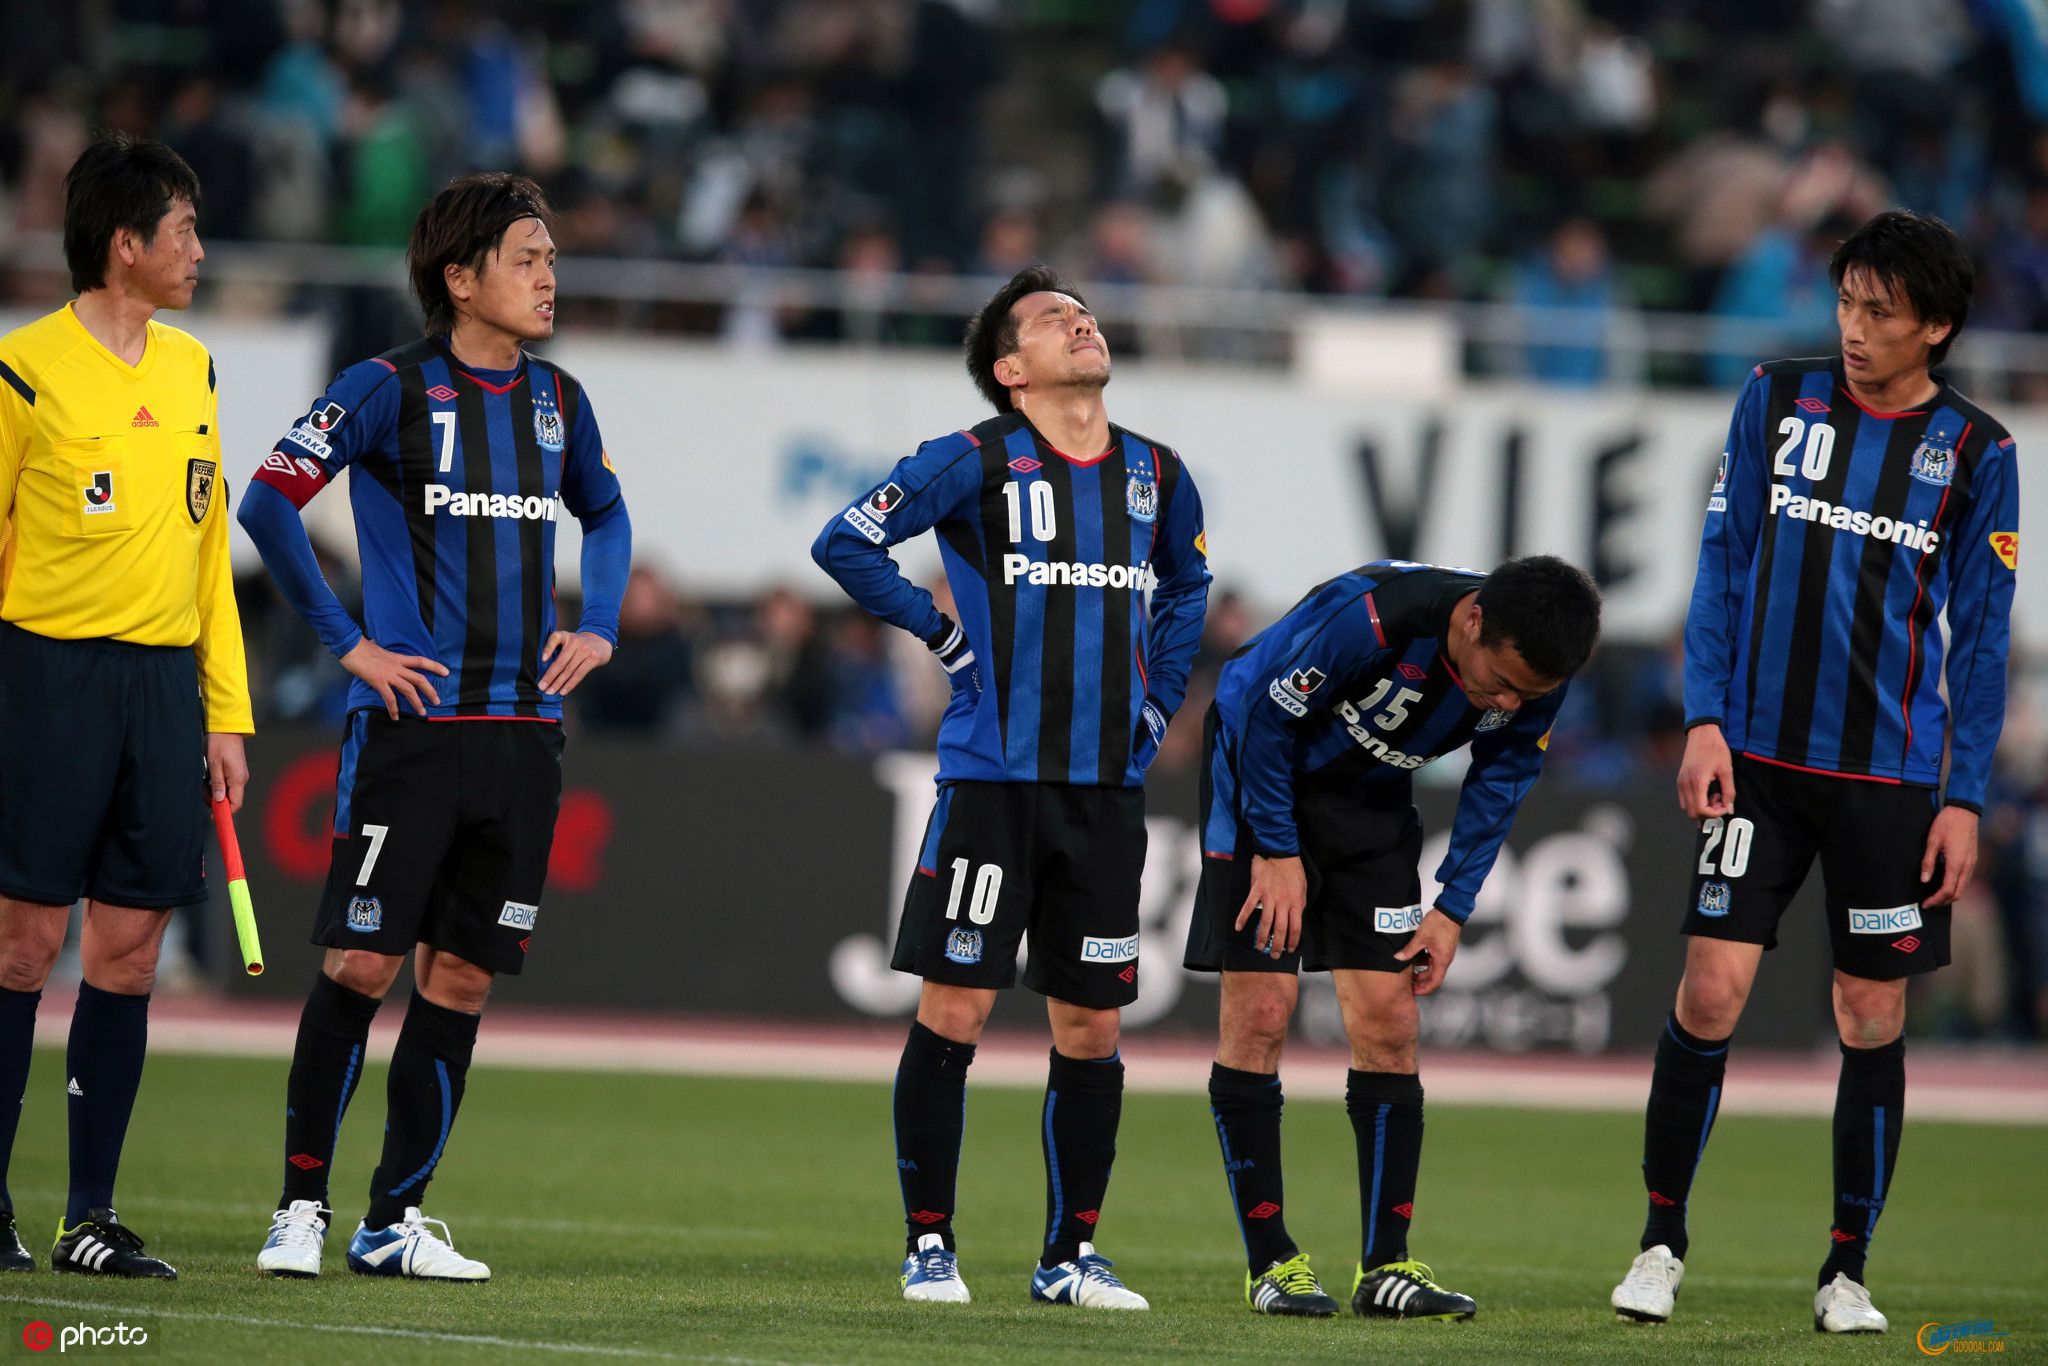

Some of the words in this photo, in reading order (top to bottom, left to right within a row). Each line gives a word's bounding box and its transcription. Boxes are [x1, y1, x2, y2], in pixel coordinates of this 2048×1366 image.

[131, 419, 160, 428] adidas
[290, 430, 327, 455] OSAKA
[432, 411, 456, 472] 7
[1774, 416, 1836, 481] 20
[425, 484, 559, 522] Panasoni
[848, 511, 880, 540] OSAKA
[1002, 480, 1057, 543] 10
[1769, 484, 1940, 554] Panasonic
[1271, 684, 1302, 713] OSAKA
[1357, 678, 1424, 731] 15
[1332, 700, 1440, 770] Panaso
[355, 824, 389, 886] 7
[1698, 816, 1755, 878] 20
[945, 857, 1003, 925] 10
